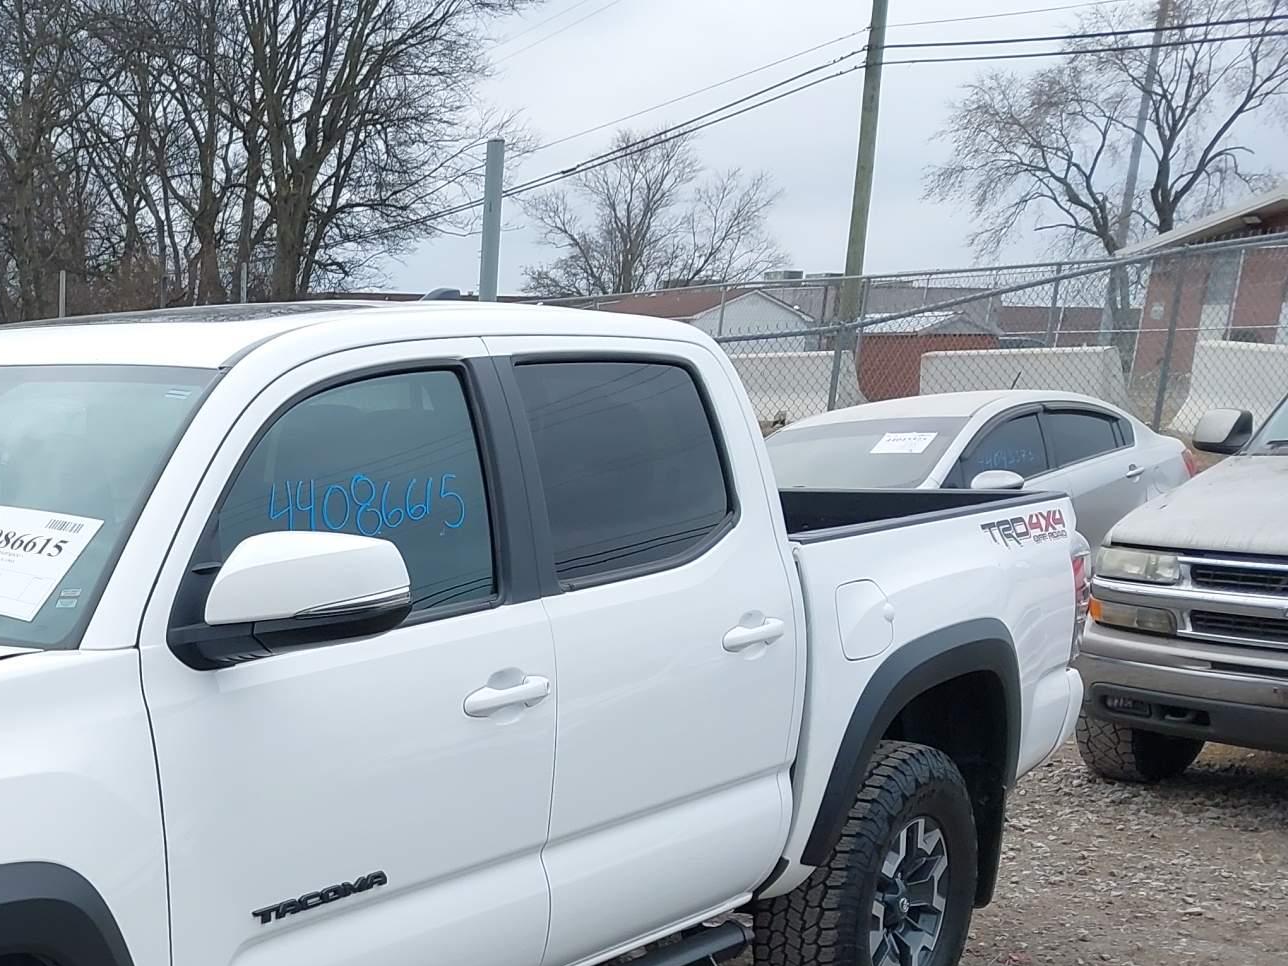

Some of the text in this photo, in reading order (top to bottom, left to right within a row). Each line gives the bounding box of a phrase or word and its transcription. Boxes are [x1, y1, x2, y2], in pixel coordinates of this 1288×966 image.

[269, 474, 465, 536] 44086615
[980, 516, 1031, 549] TRD
[252, 870, 388, 924] TACOMA
